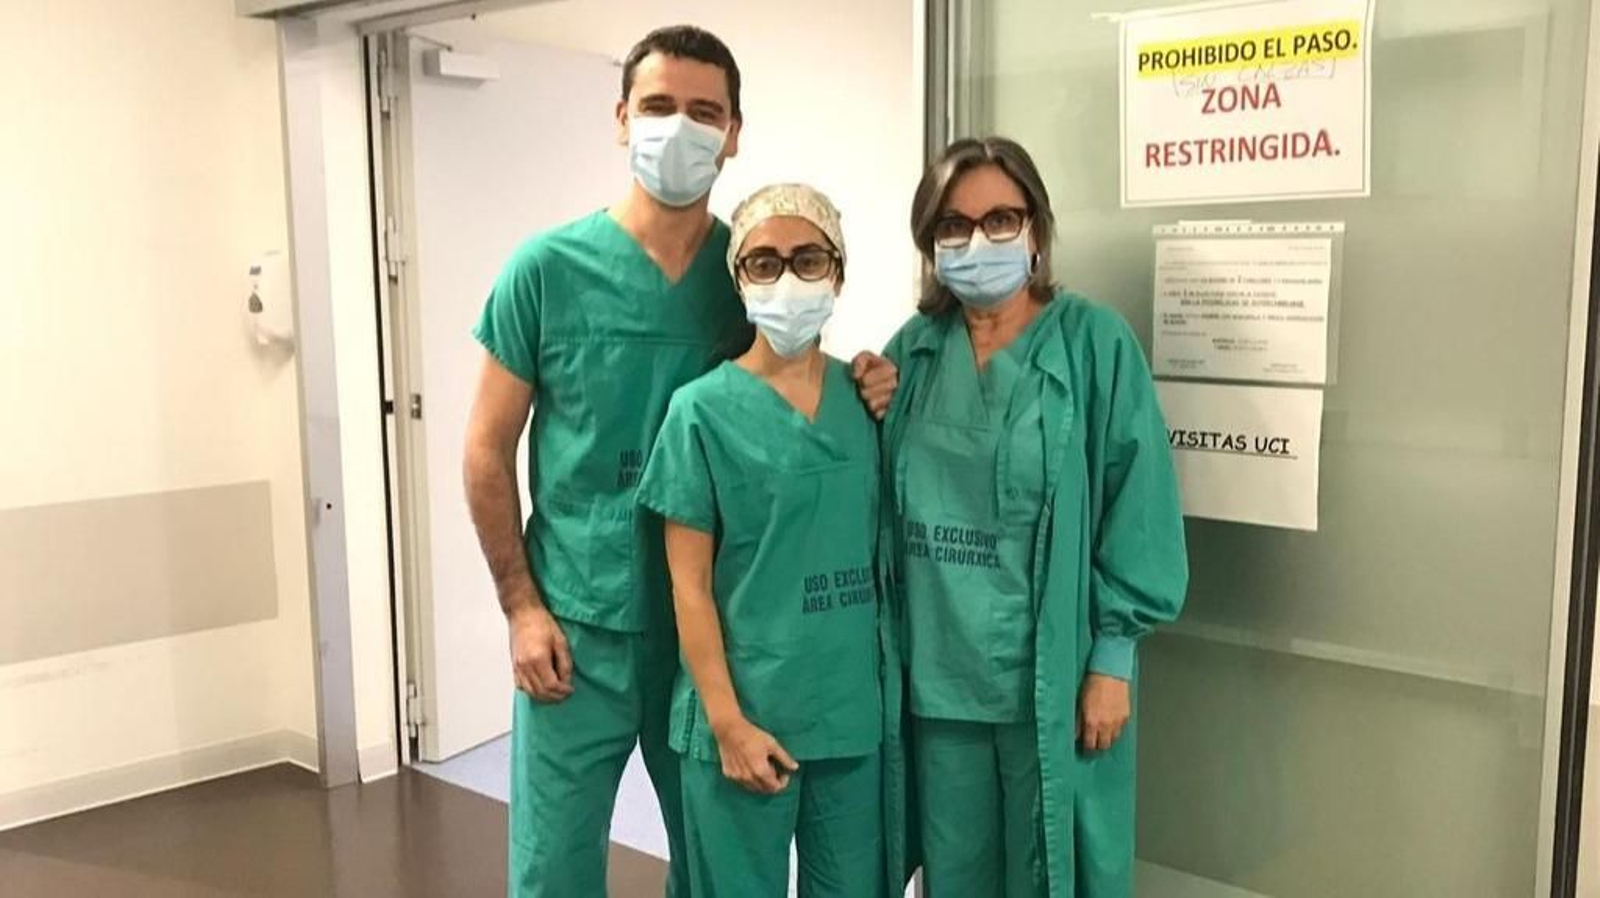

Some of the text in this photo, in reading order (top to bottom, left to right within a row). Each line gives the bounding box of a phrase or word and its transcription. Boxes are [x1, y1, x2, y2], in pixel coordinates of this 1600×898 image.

[1138, 29, 1358, 71] PROHIBIDO EL PASO.
[1201, 82, 1282, 115] ZONA
[1145, 129, 1341, 168] RESTRINGIDA.
[1167, 429, 1290, 455] VISITAS UCI
[803, 574, 828, 594] USO
